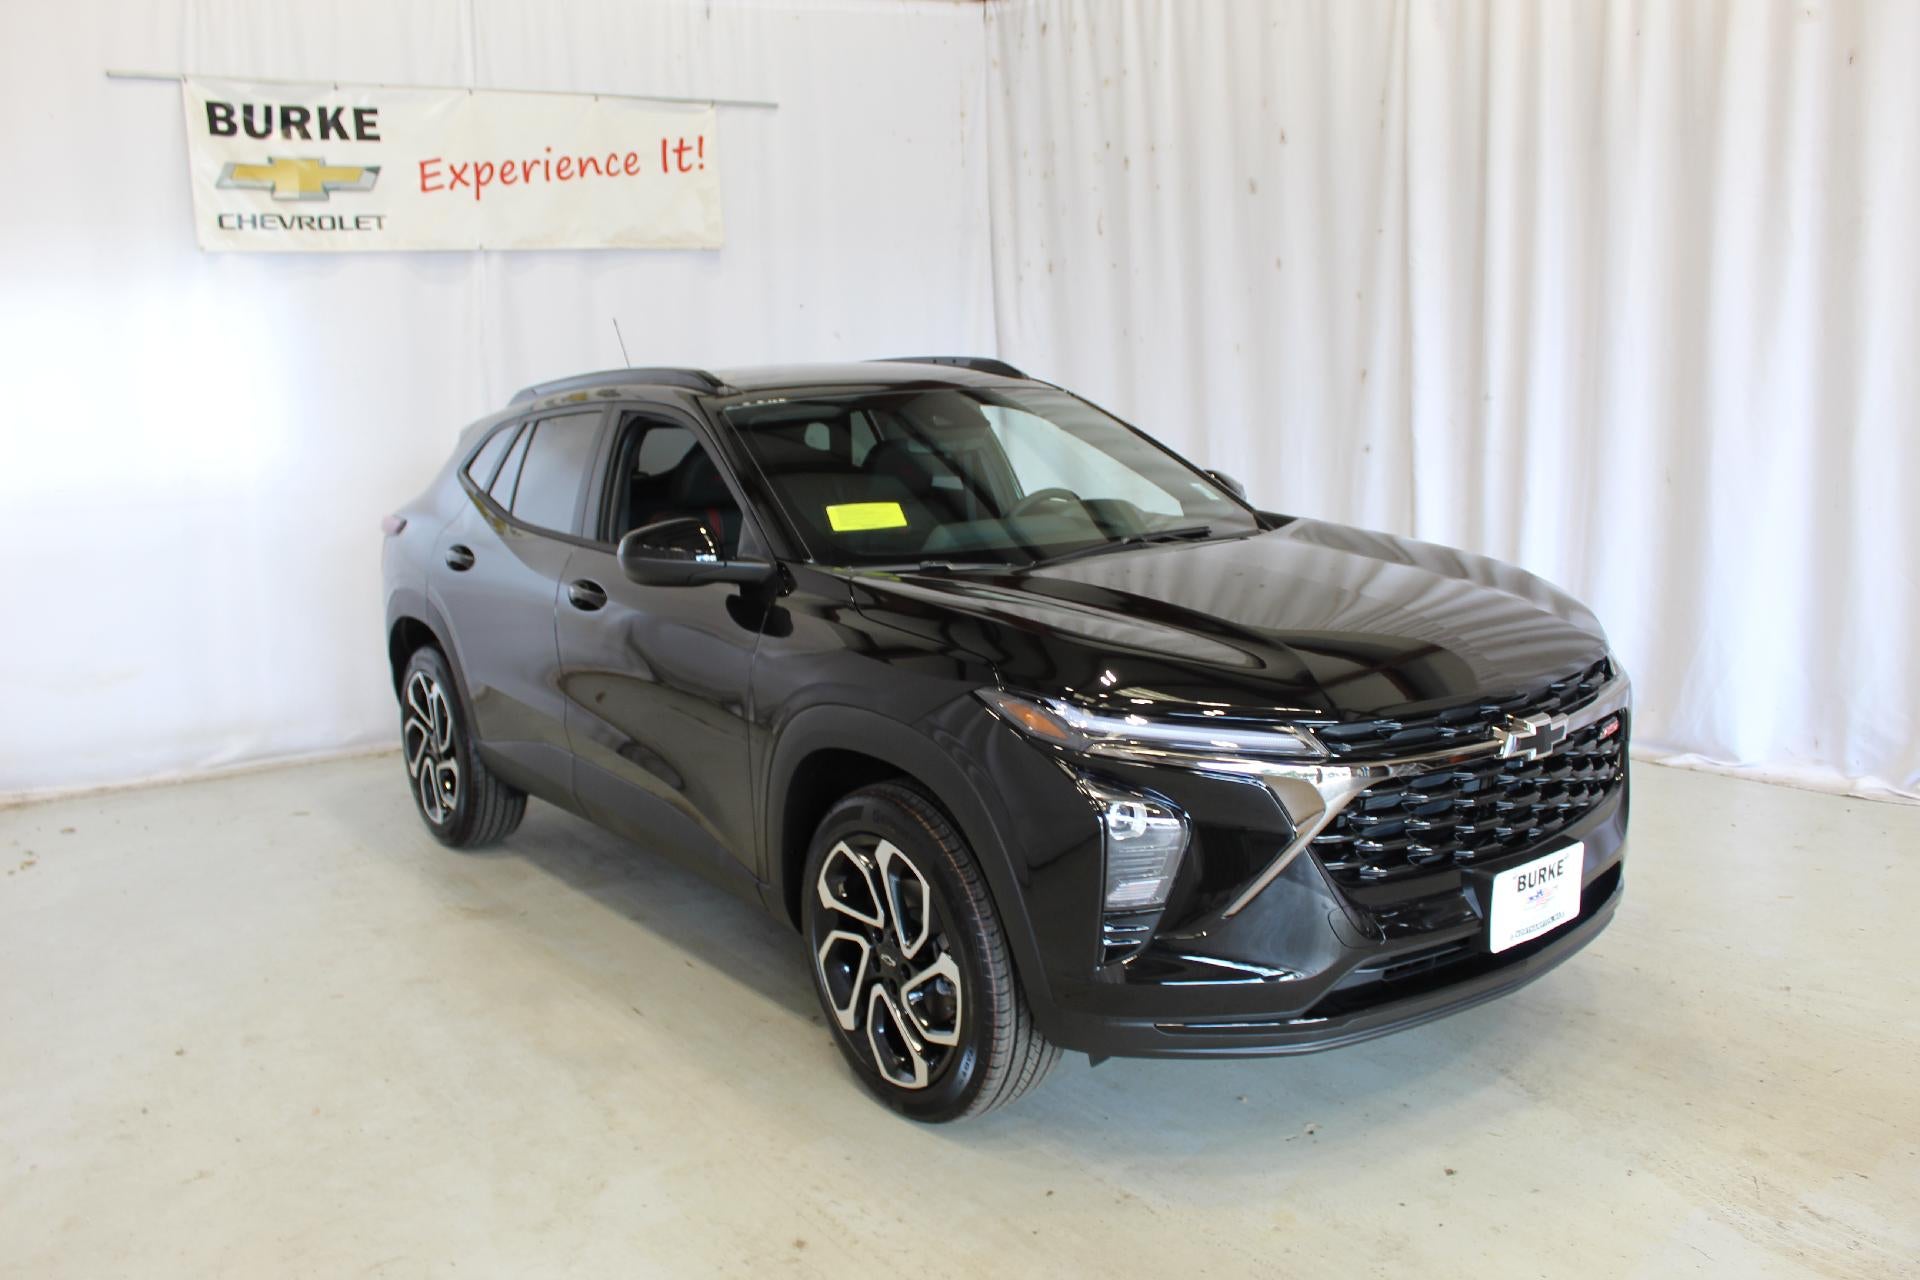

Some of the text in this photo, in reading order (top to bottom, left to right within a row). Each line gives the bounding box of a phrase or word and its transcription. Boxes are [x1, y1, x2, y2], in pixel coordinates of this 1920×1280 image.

[205, 100, 381, 142] BURKE
[419, 135, 705, 201] Experience It!
[217, 213, 387, 231] CHEVROLET
[1516, 859, 1565, 893] BURKE
